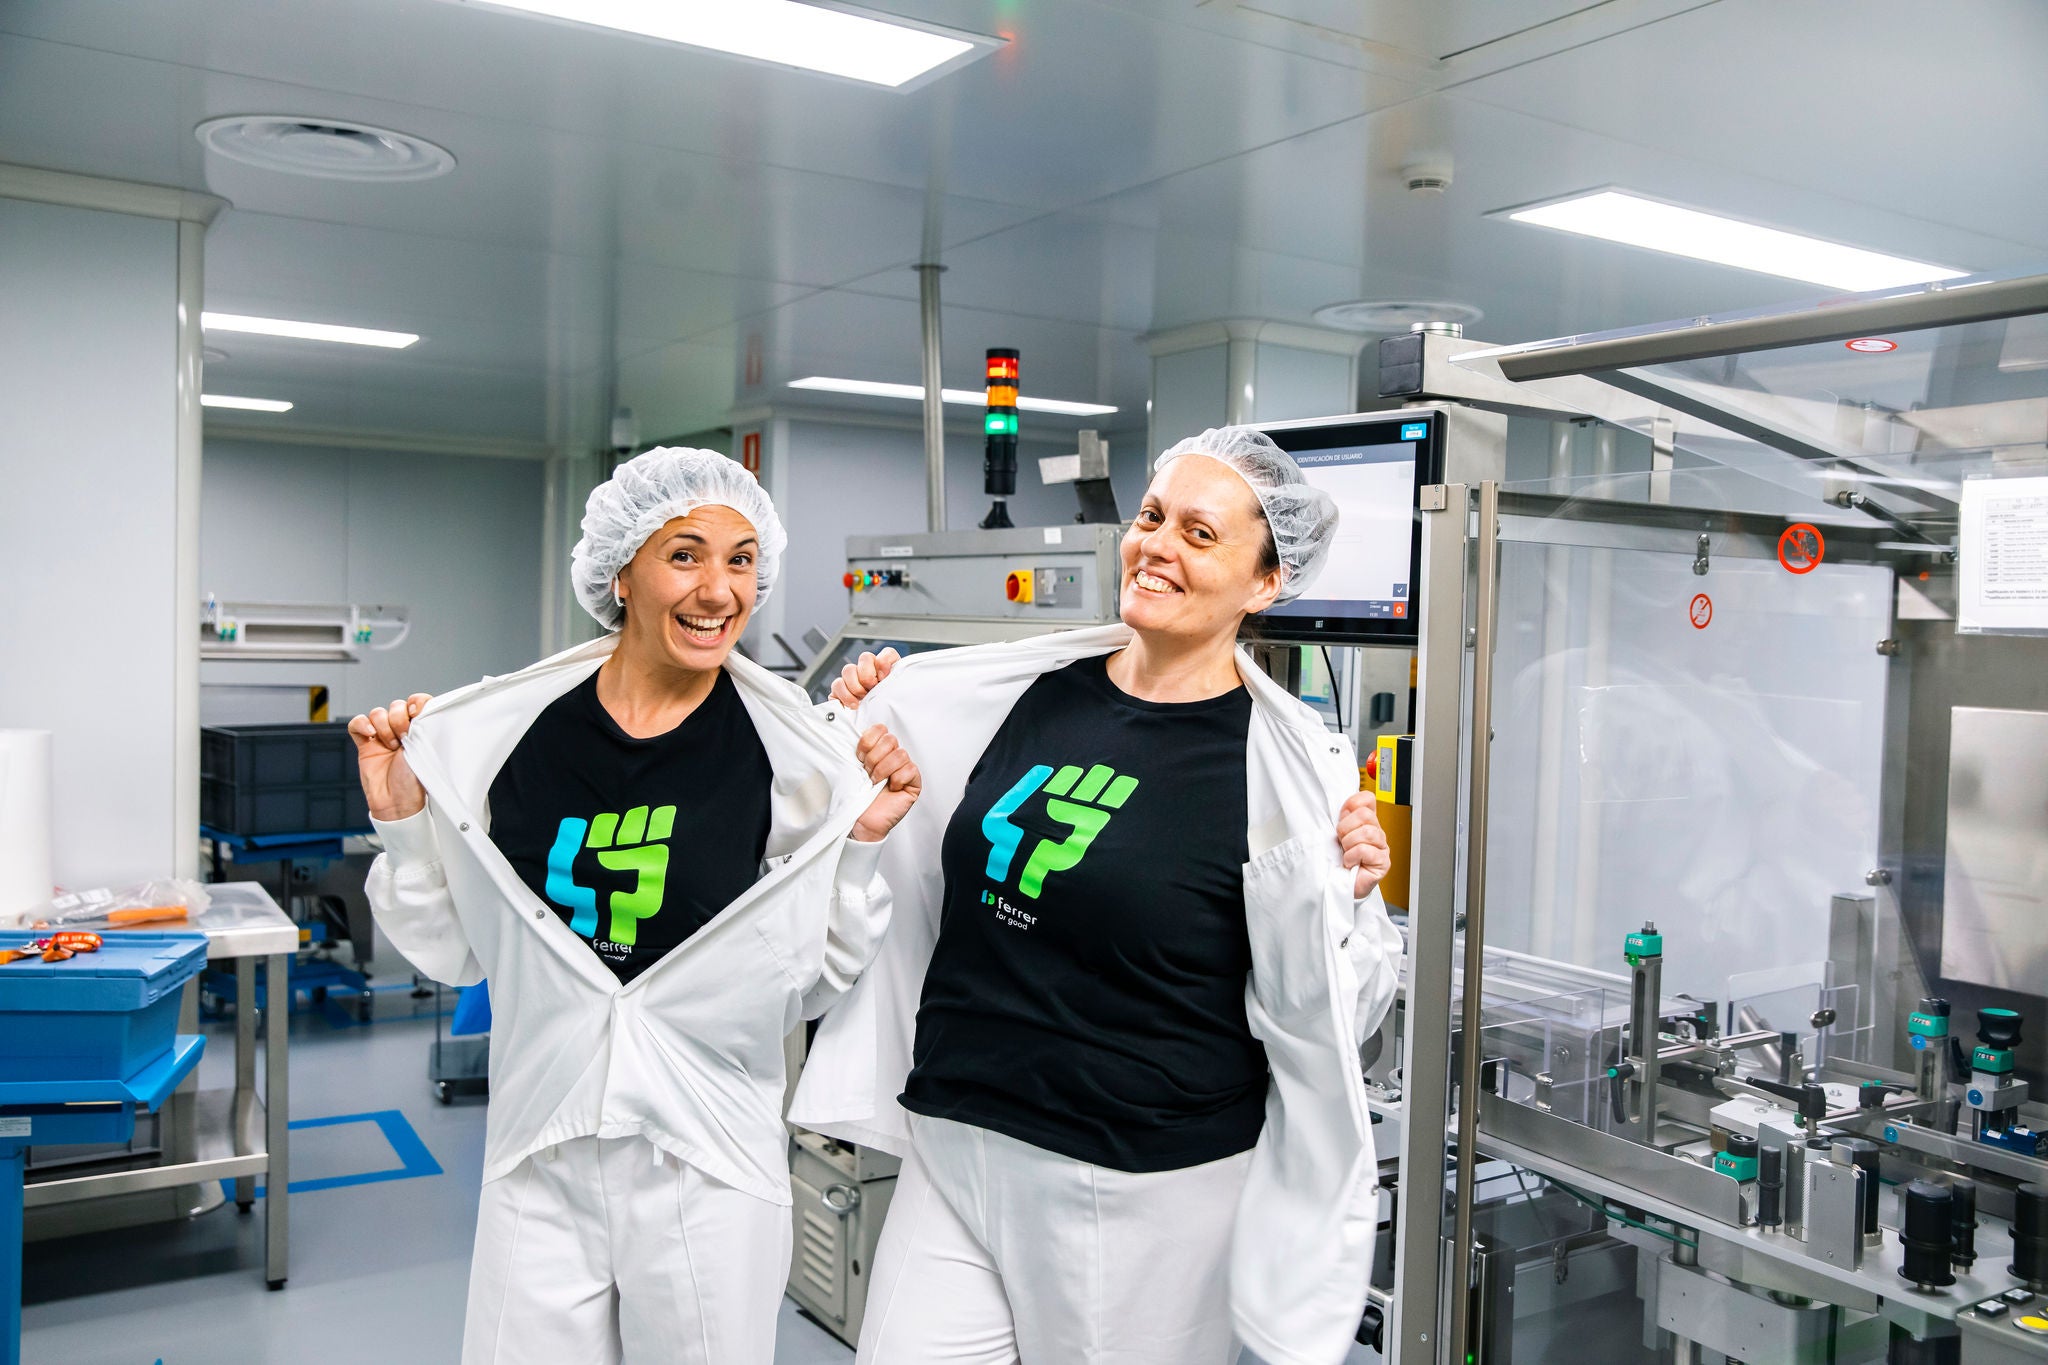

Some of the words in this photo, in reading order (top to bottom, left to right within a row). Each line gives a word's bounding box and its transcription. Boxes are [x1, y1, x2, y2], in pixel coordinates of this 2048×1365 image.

[1297, 454, 1333, 463] IDENTIFICACIÓN
[996, 910, 1007, 920] for
[1007, 918, 1028, 930] good
[998, 896, 1037, 925] ferrer
